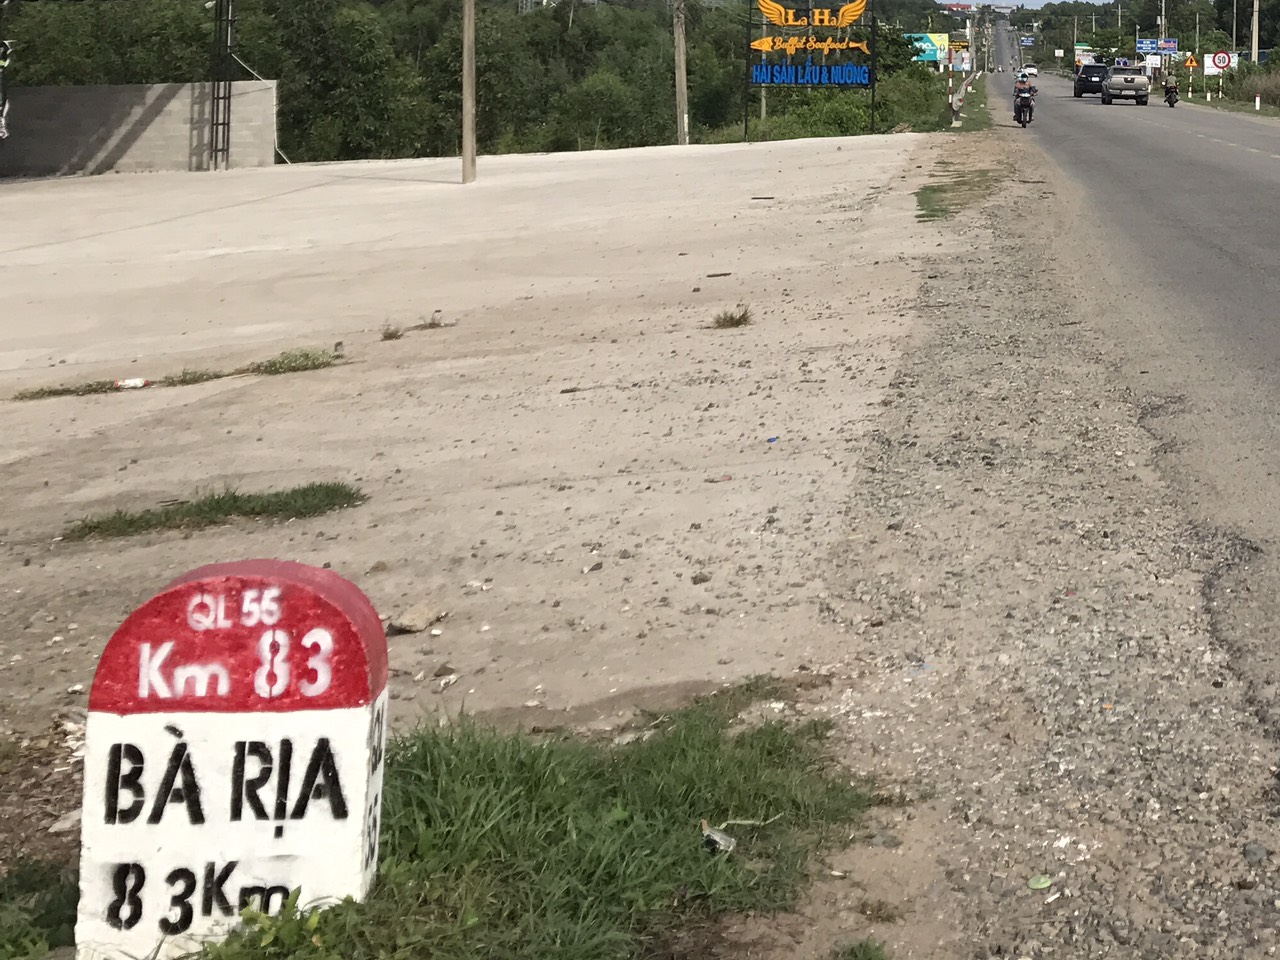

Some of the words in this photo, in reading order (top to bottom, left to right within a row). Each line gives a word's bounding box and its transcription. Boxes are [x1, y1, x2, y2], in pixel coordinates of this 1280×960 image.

[773, 36, 806, 55] Buffet
[807, 35, 848, 55] Seafood
[1217, 56, 1226, 64] 50
[753, 58, 771, 83] HẢI
[773, 58, 796, 83] SẢN
[821, 65, 829, 83] &
[187, 593, 232, 631] QL
[138, 640, 230, 698] Km
[254, 628, 334, 698] 83
[104, 724, 206, 825] BÀ
[230, 737, 349, 839] RỊA
